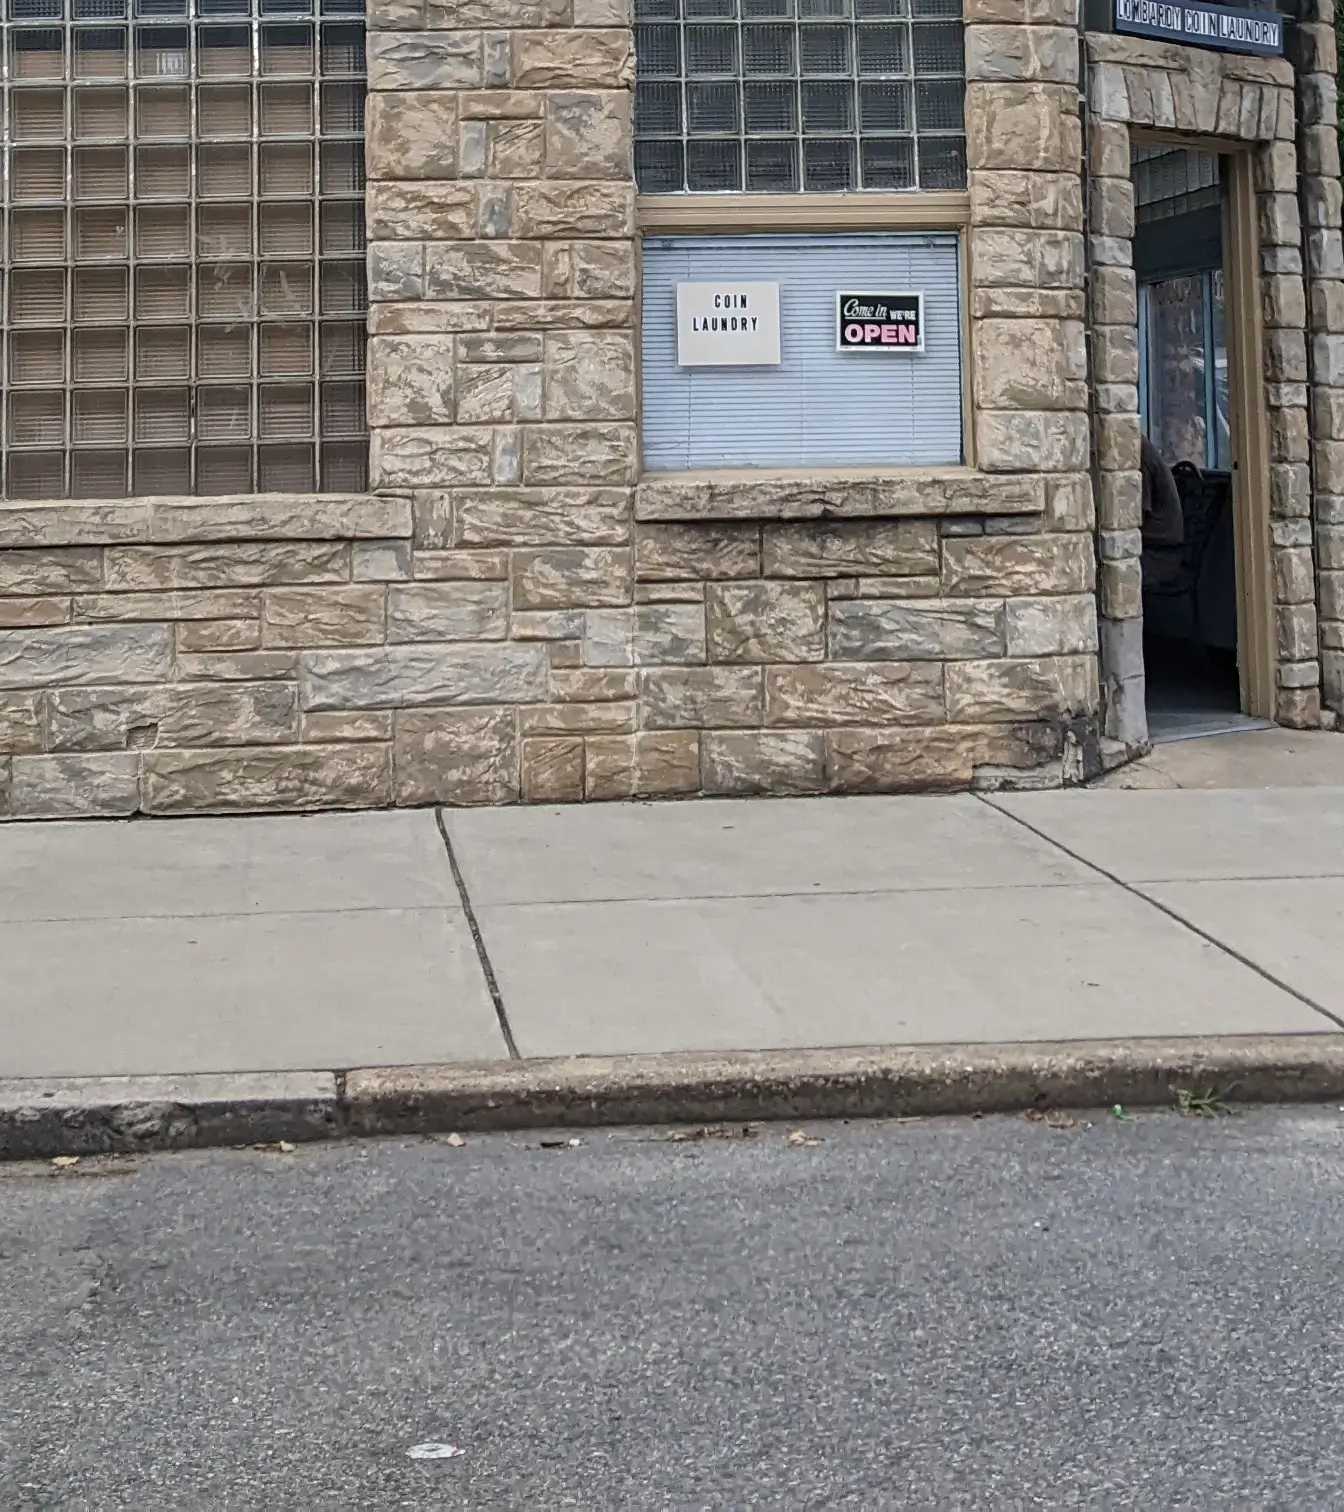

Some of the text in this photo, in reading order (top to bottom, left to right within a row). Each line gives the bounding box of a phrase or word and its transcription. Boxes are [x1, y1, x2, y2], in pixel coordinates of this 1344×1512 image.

[1184, 8, 1218, 36] COIN
[1219, 15, 1279, 46] LAUNDRY
[714, 294, 748, 309] COIN
[843, 298, 874, 317] Come
[889, 310, 917, 320] WE'RE
[692, 317, 758, 332] LAUNDRY
[844, 323, 916, 343] OPEN
